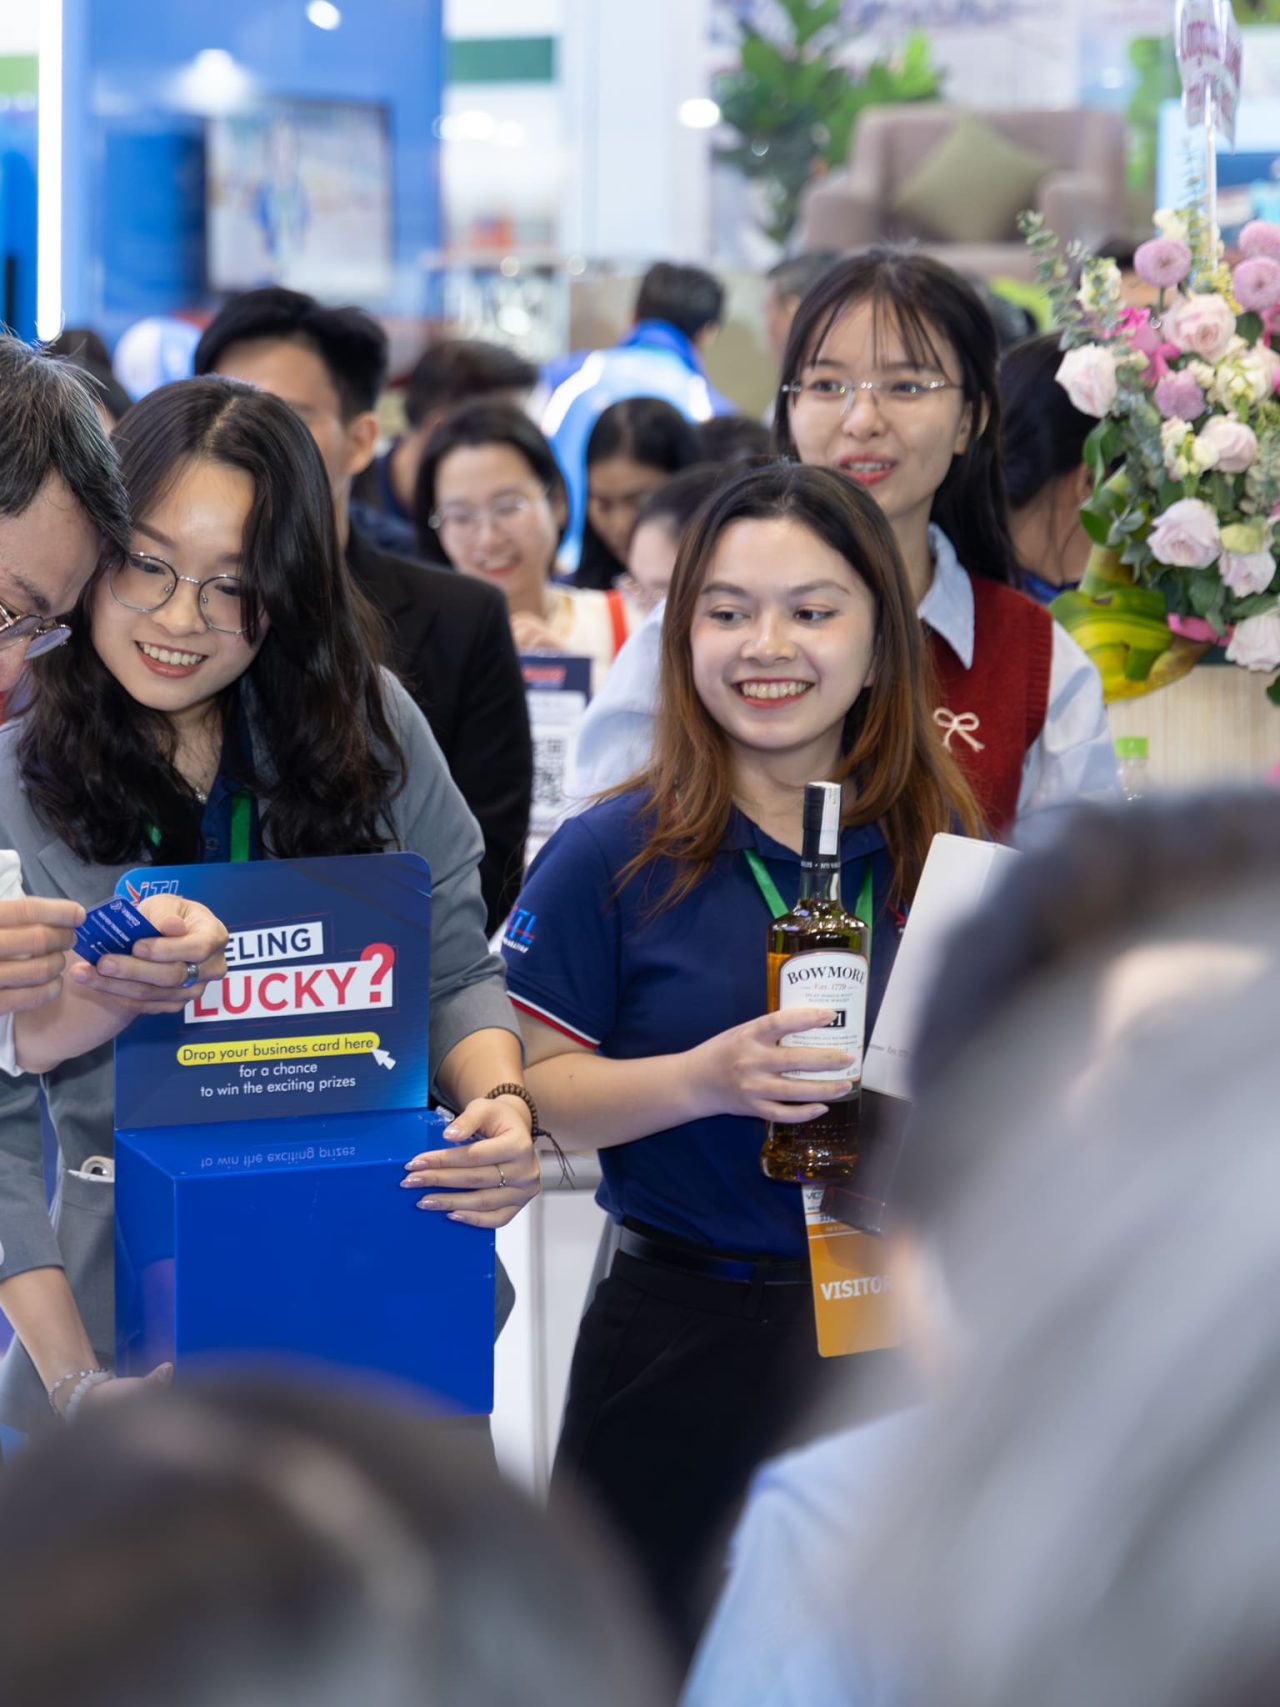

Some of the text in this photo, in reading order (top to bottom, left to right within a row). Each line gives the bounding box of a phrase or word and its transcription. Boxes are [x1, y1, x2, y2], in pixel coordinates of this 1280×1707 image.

[225, 928, 312, 961] ELING
[193, 943, 396, 1017] LUCKY?
[786, 966, 865, 985] BOWMORE
[183, 1037, 374, 1063] Drop your business card here
[239, 1062, 318, 1078] for a chance
[200, 1076, 356, 1097] to win the exciting prizes
